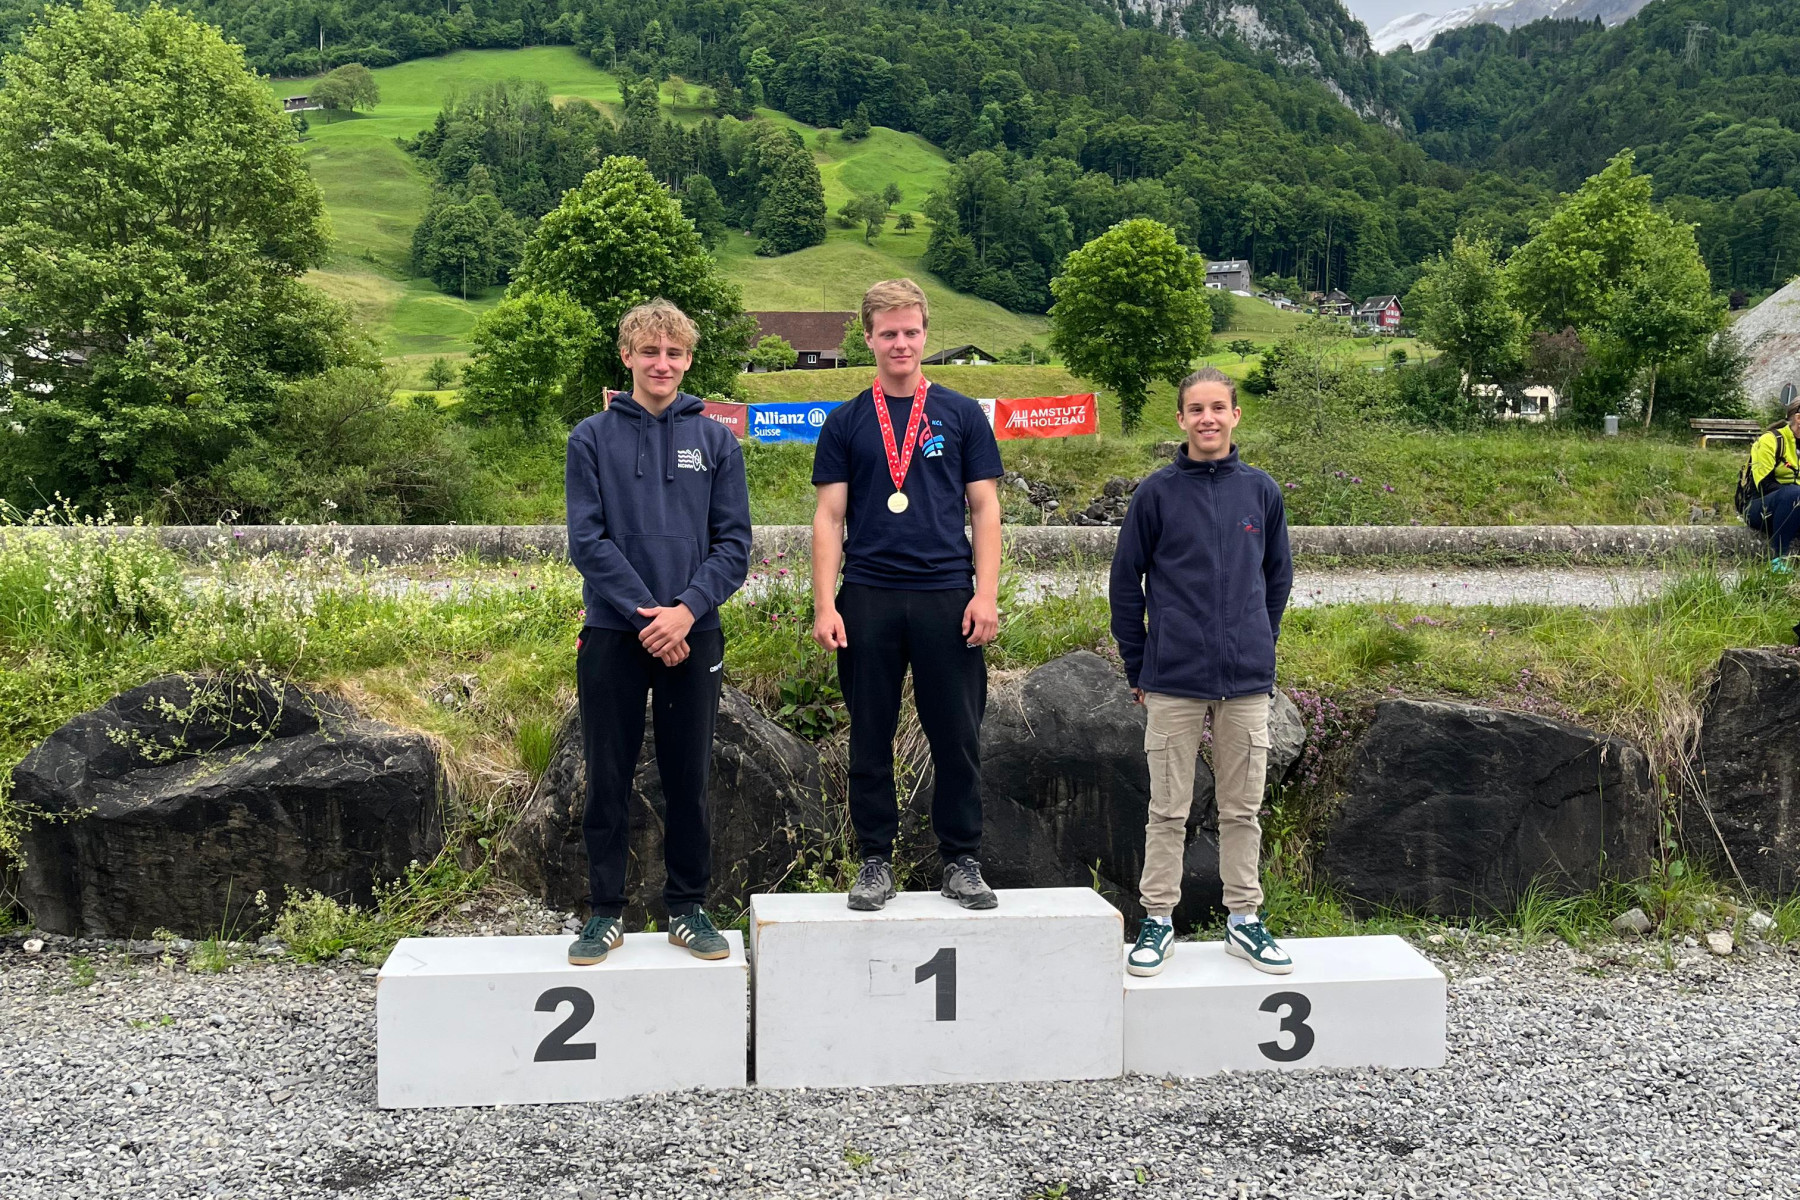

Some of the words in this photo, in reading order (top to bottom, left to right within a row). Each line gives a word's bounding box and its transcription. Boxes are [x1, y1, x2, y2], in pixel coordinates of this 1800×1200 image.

[754, 411, 805, 425] Allianz
[1030, 405, 1086, 418] AMSTUTZ
[709, 414, 738, 424] Klima
[1030, 415, 1086, 427] HOLZBAU
[754, 426, 781, 437] Suisse
[915, 947, 956, 1021] 1
[533, 986, 597, 1063] 2
[1257, 991, 1315, 1063] 3
